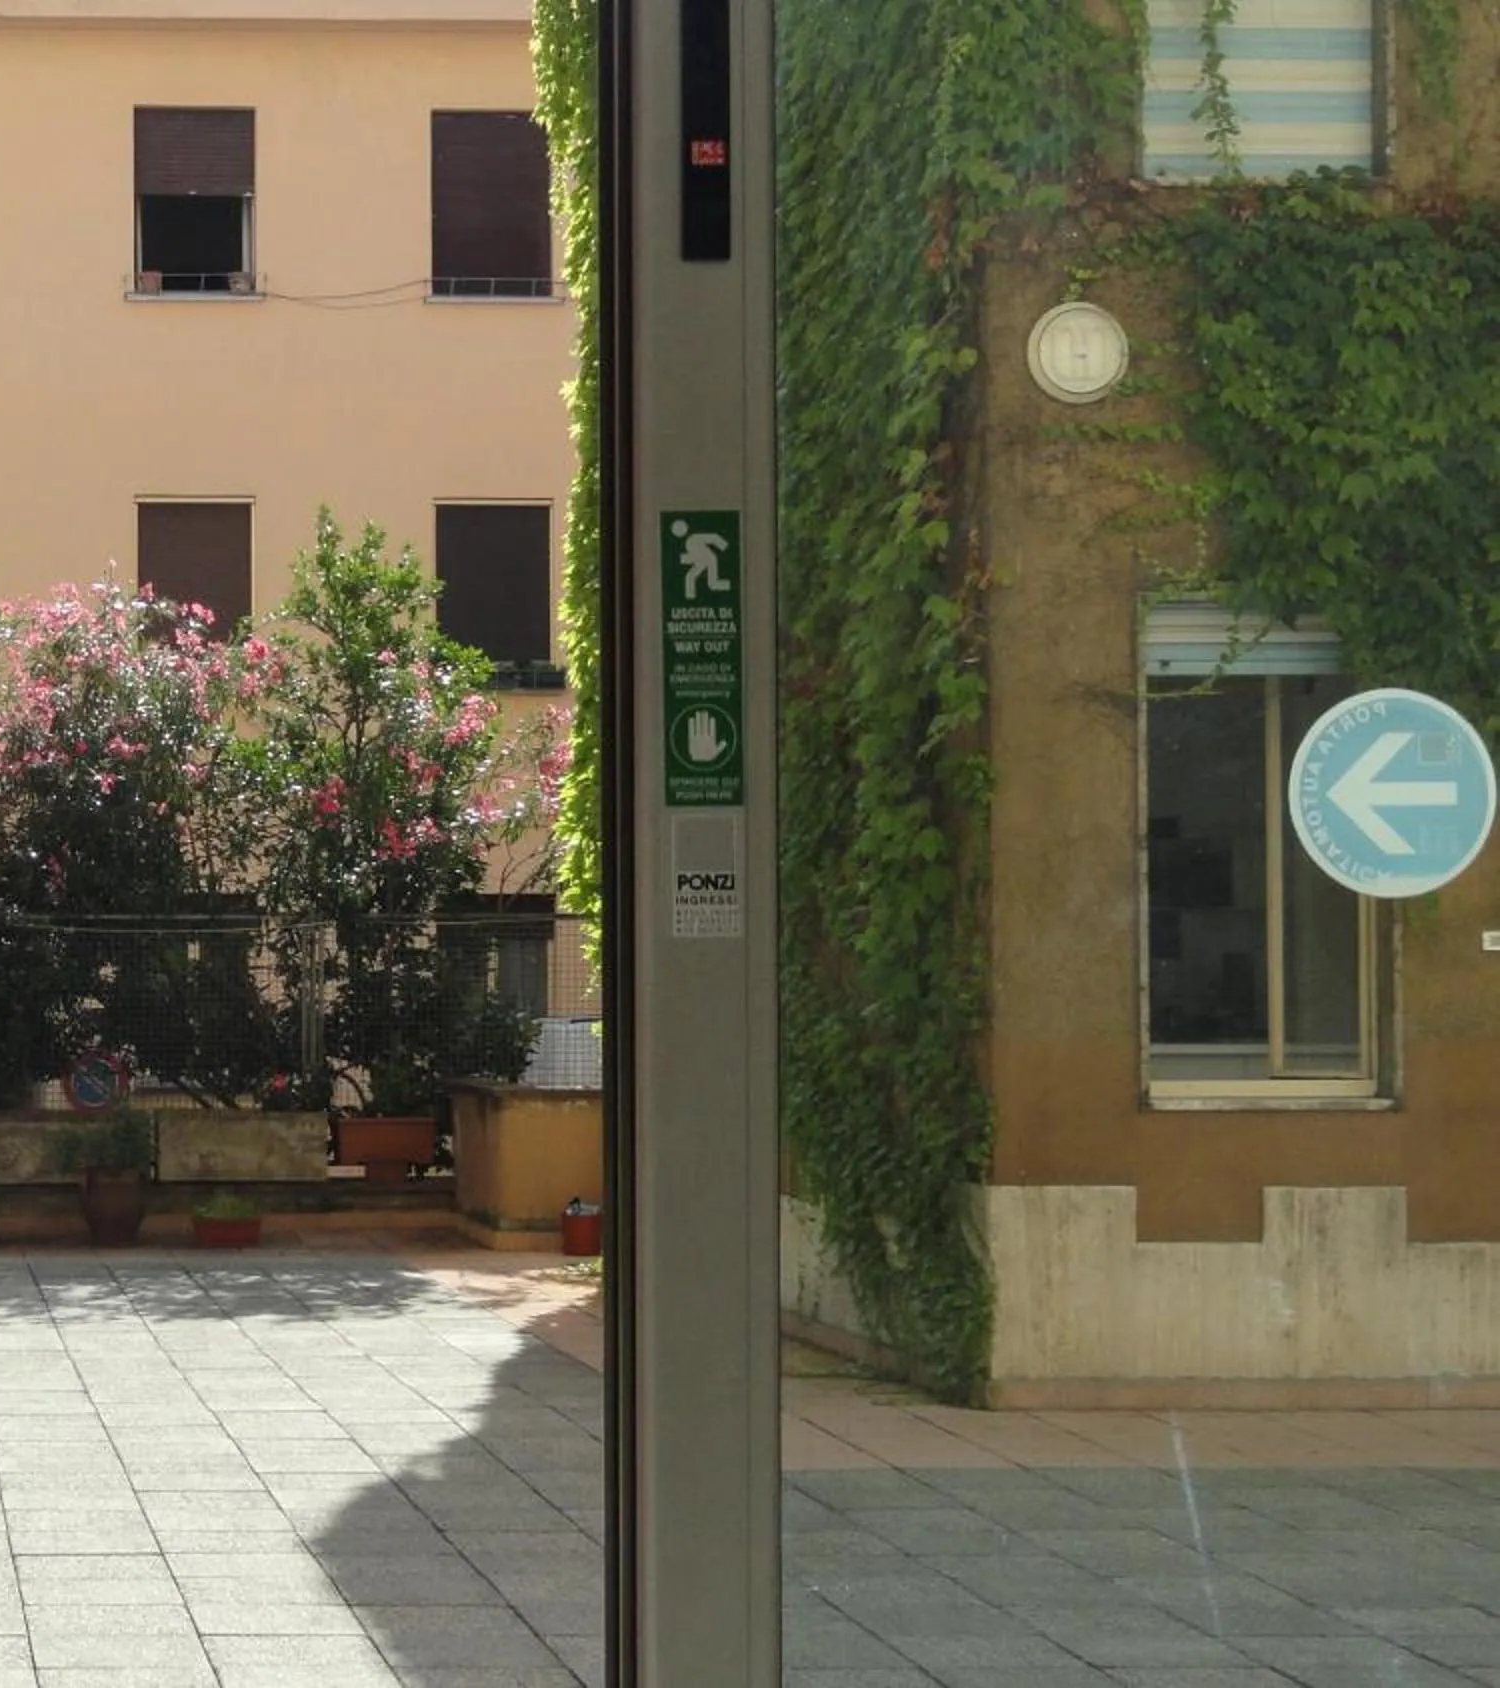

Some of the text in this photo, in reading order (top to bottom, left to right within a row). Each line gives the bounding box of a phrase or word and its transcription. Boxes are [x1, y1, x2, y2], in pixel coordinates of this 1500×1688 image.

[671, 607, 734, 619] USCITA DI
[667, 621, 737, 634] SICUREZZA
[674, 640, 731, 653] WAY OUT
[678, 873, 735, 891] PONZI
[676, 895, 738, 906] INGRESSI
